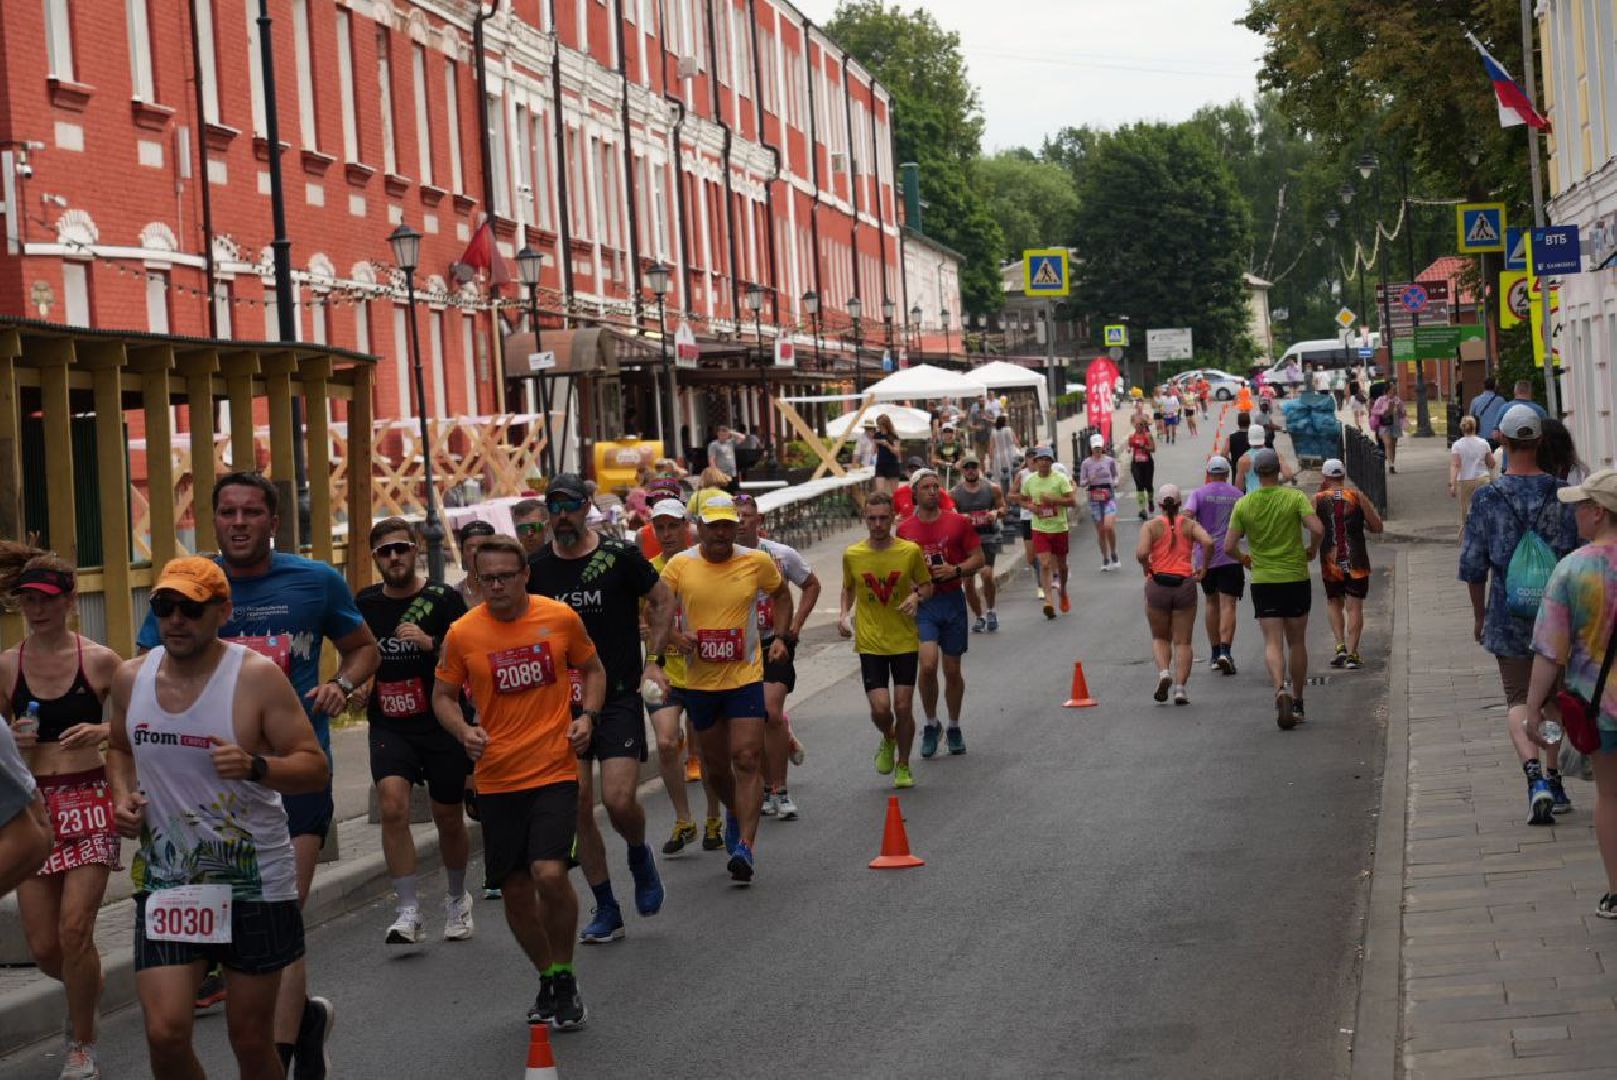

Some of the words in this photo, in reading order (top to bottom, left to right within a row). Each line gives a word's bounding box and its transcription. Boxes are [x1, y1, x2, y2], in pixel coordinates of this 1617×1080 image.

[1545, 233, 1567, 246] ВТБ
[700, 641, 734, 660] 2048
[496, 660, 543, 691] 2088
[381, 693, 417, 713] 2365
[134, 727, 179, 746] grom
[58, 805, 107, 834] 2310
[153, 907, 214, 937] 3030
